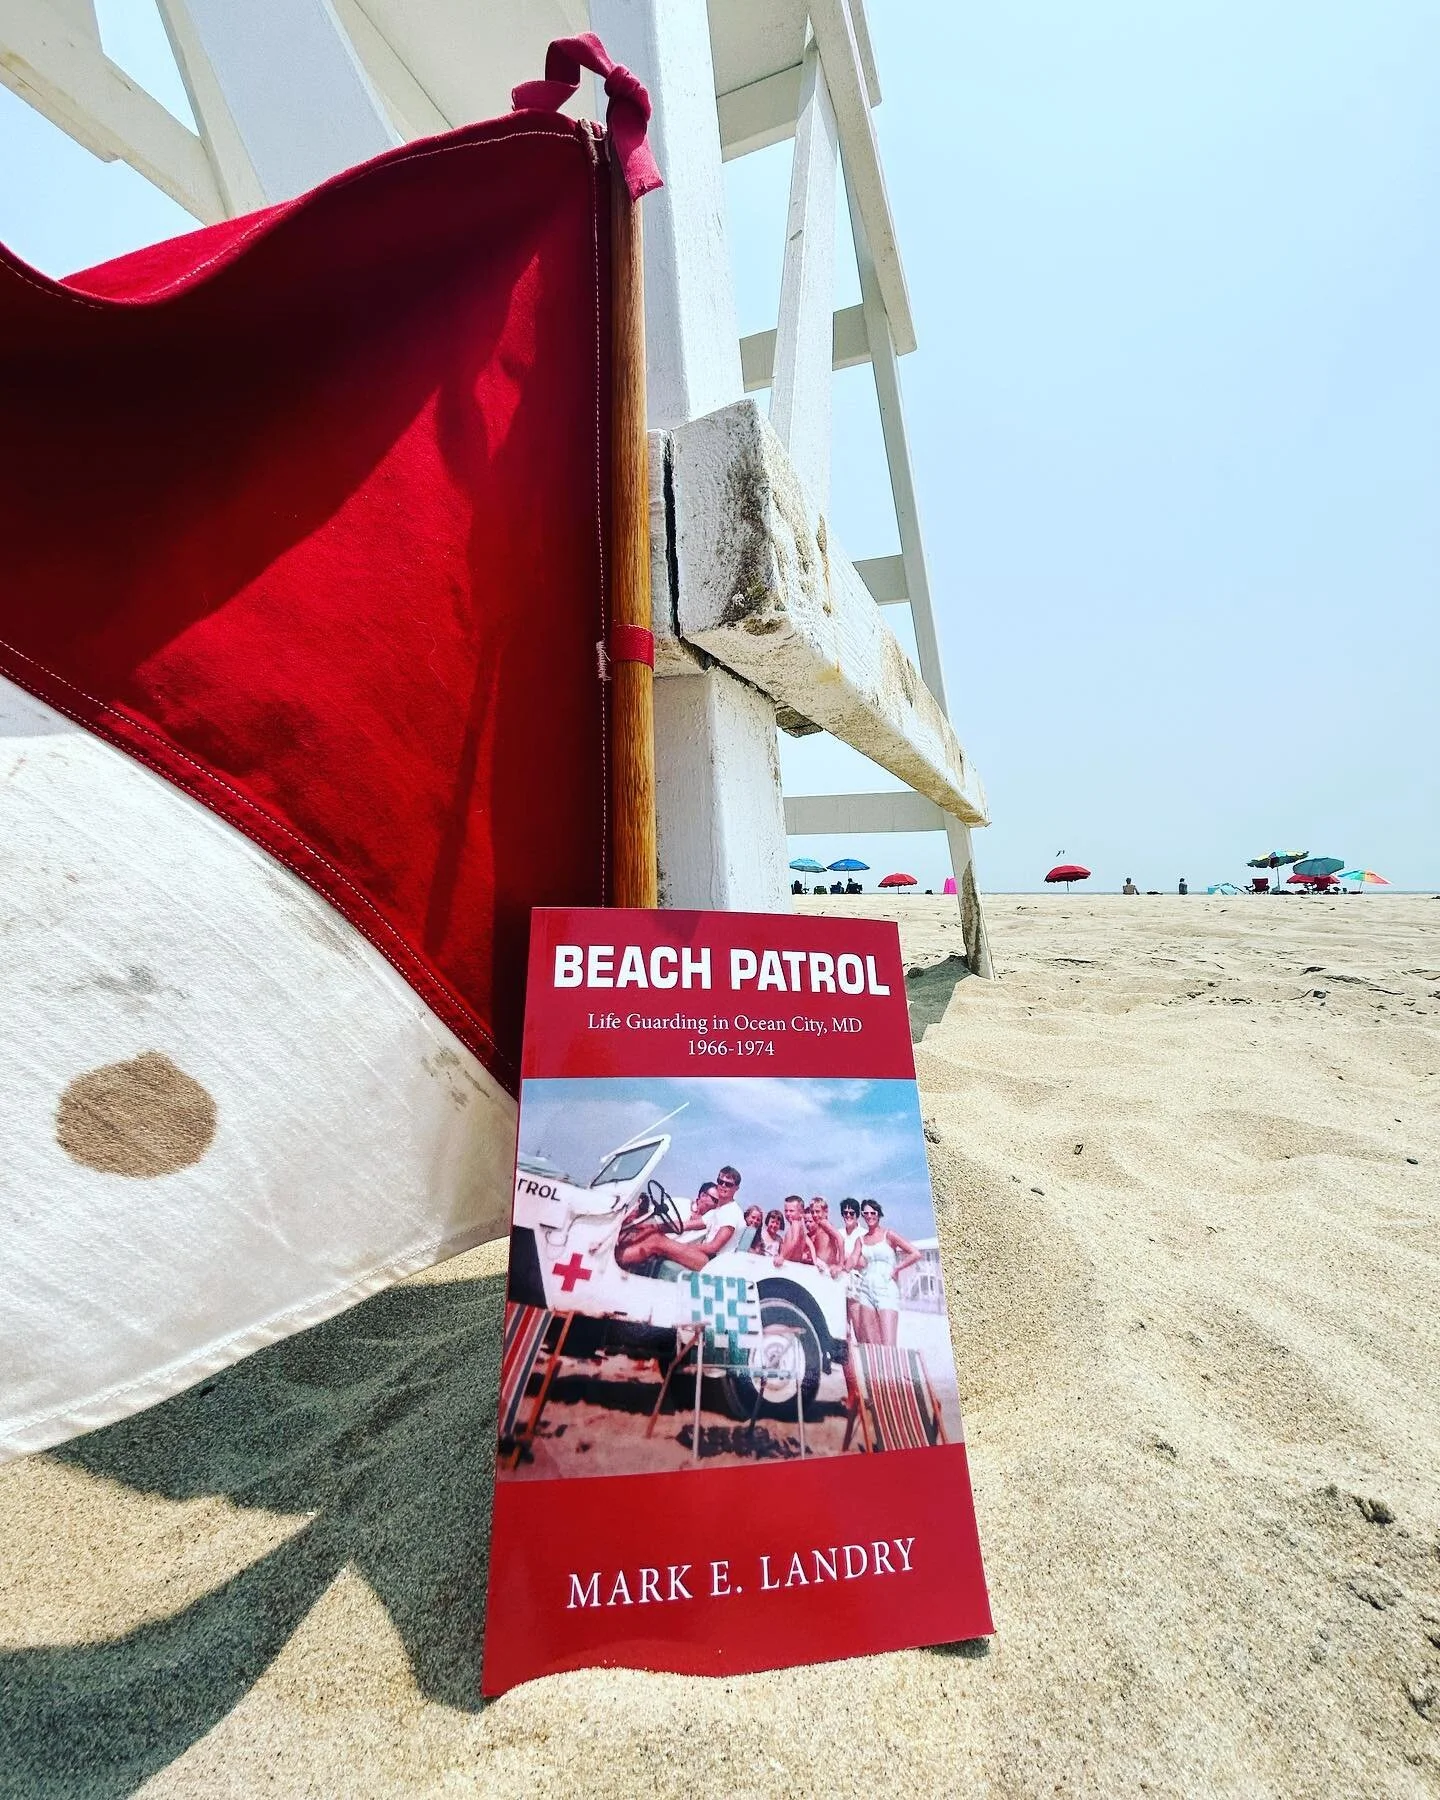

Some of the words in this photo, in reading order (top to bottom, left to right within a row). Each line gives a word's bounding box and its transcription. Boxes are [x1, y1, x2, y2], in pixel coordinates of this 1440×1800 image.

[553, 945, 712, 990] BEACH
[730, 948, 891, 996] PATROL
[587, 1012, 622, 1030] Life
[626, 1012, 709, 1035] Guarding
[712, 1013, 730, 1031] in
[733, 1014, 787, 1032] Ocean
[790, 1015, 828, 1037] City,
[831, 1016, 863, 1034] MD
[688, 1039, 775, 1056] 1966-1974
[566, 1564, 694, 1609] MARK
[709, 1560, 743, 1597] E.
[759, 1537, 916, 1590] LANDRY
